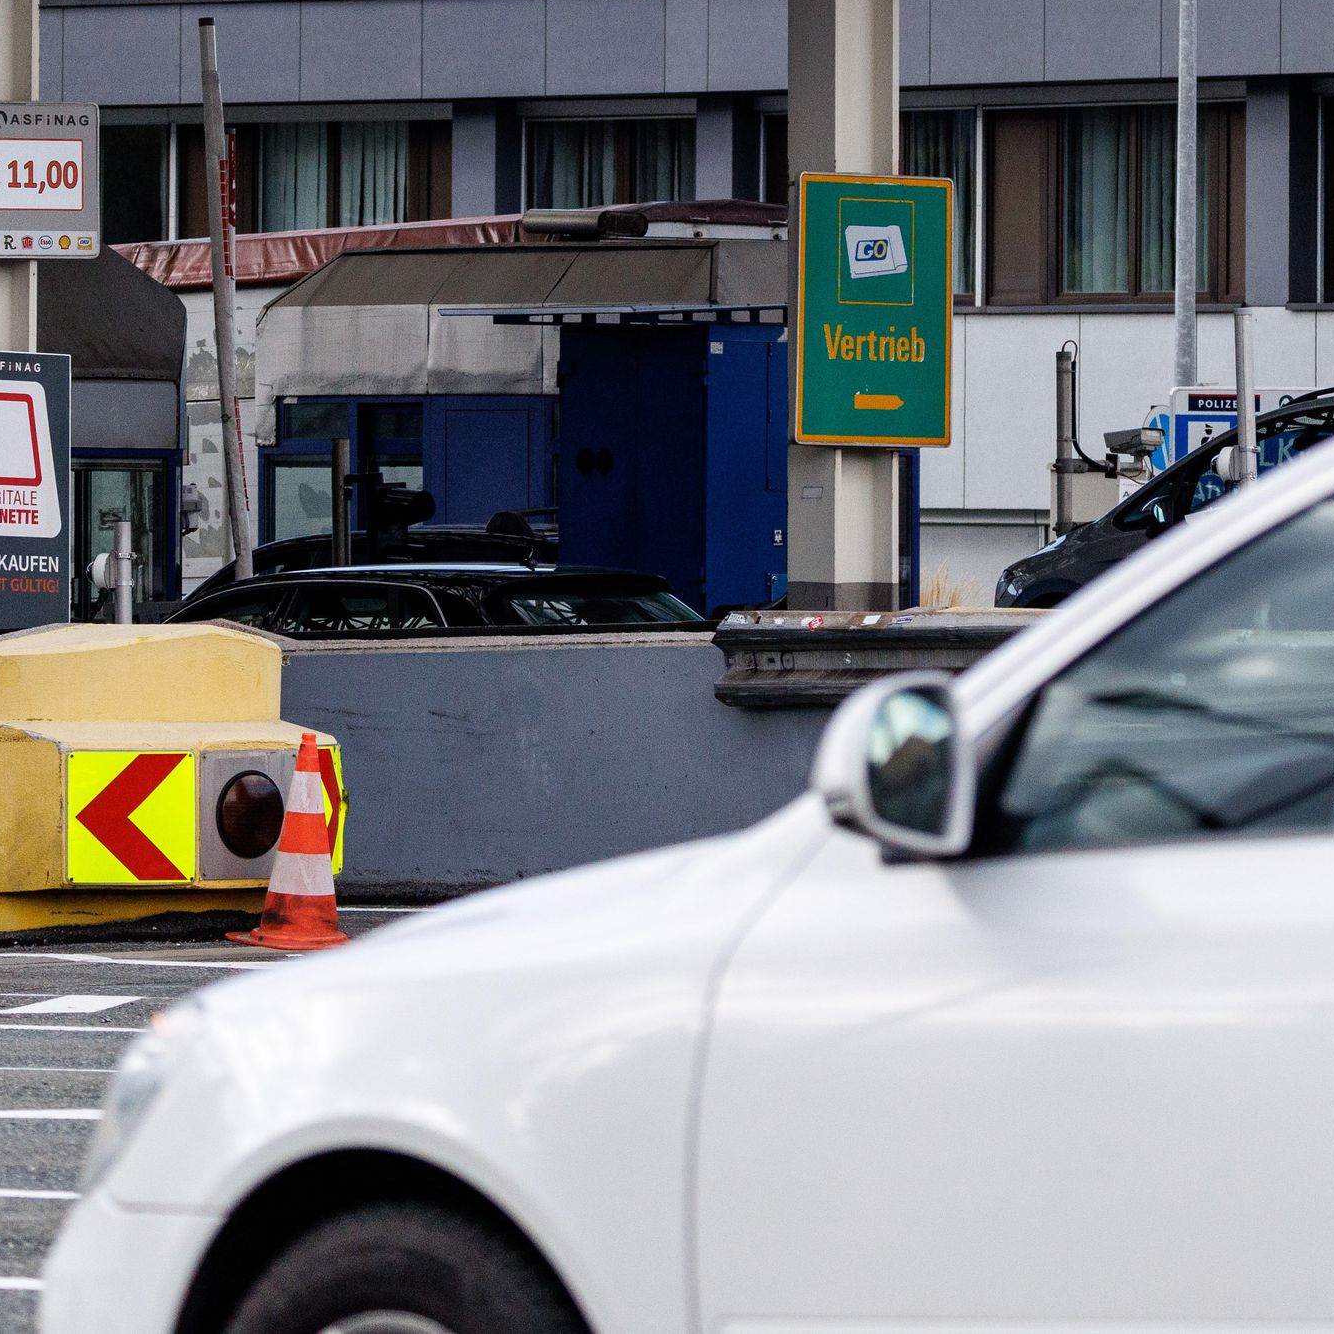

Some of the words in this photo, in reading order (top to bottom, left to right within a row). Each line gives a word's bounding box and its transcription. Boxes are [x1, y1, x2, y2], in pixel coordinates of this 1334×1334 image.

[7, 160, 78, 194] 11,00
[856, 239, 888, 261] GO
[823, 323, 926, 363] Vertrieb
[1198, 399, 1238, 409] POLIZE
[10, 576, 60, 593] GÜLTIG!
